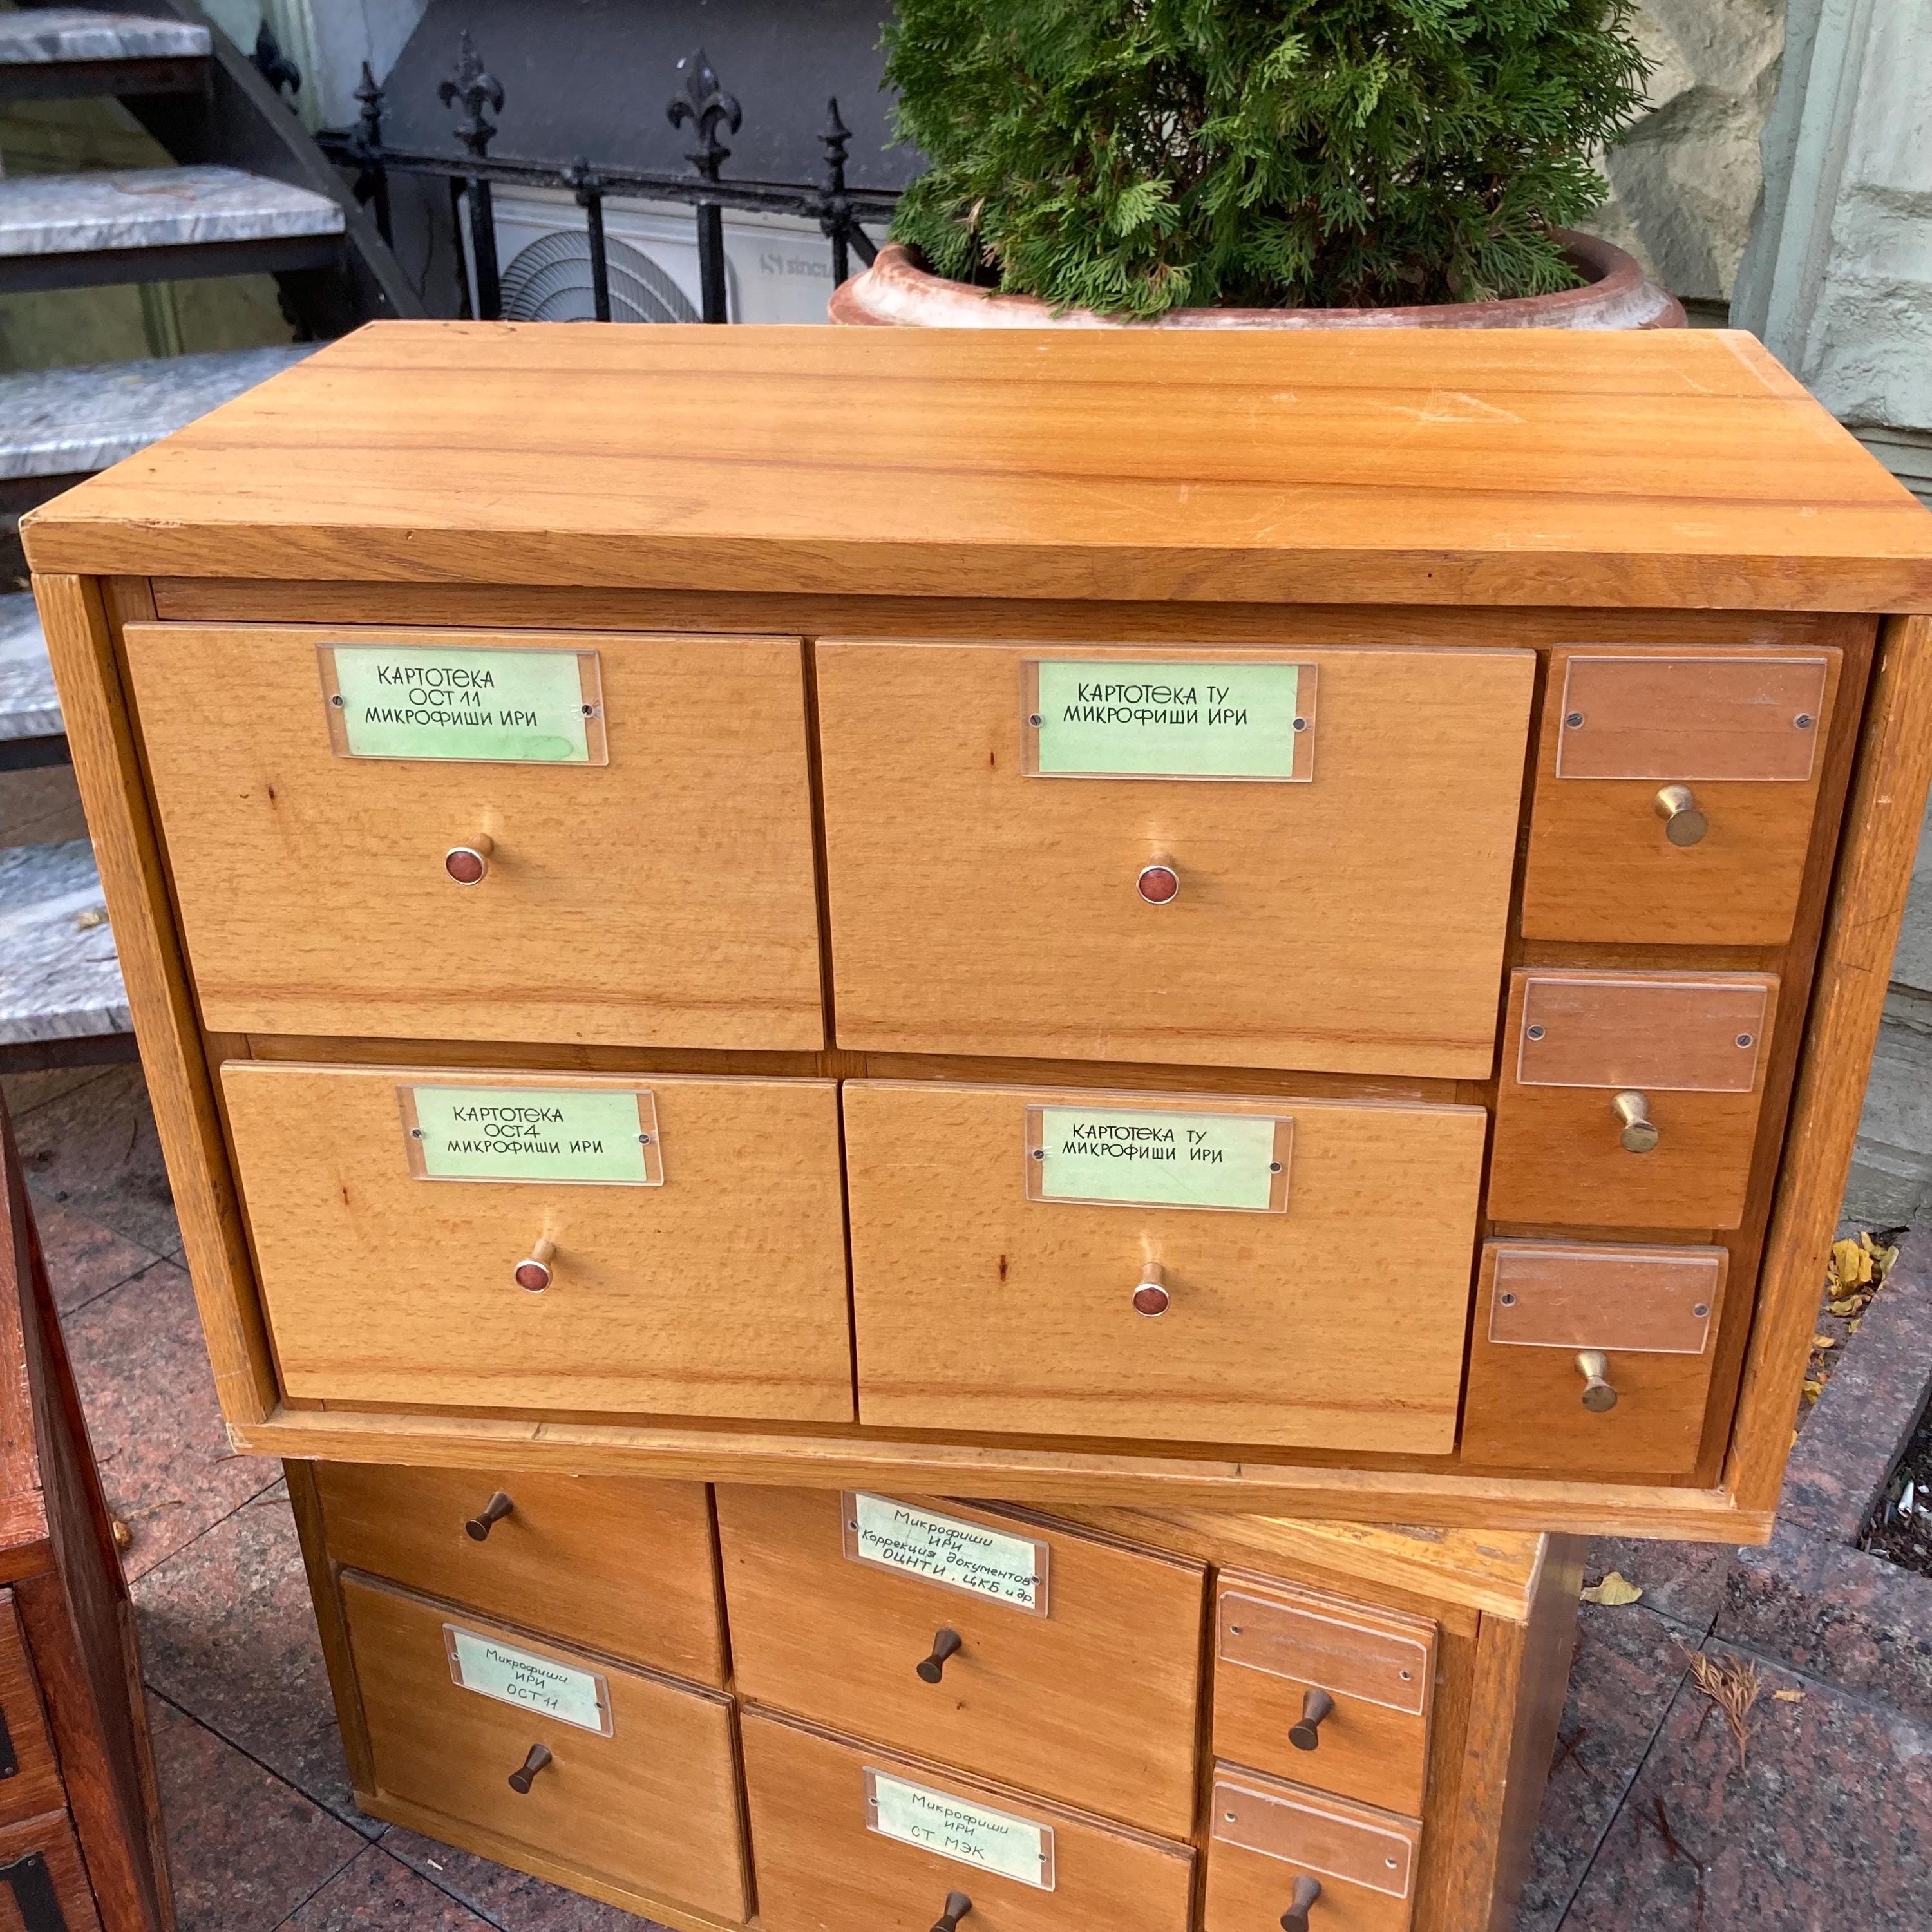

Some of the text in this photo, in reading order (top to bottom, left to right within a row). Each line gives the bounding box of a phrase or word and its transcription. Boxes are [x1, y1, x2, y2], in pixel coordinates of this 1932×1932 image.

[409, 688, 481, 707] ОСТ 11
[1207, 686, 1229, 705] ТУ
[365, 707, 538, 727] МИКРОФИШИ ИРИ
[1063, 705, 1247, 726] МИКРОФИШИ ИРИ
[1187, 1130, 1208, 1145] ТУ
[447, 1140, 604, 1155] МИКРОФИШИ ИРИ
[1061, 1141, 1224, 1164] МИКРОФИШИ ИРИ
[894, 1510, 994, 1547] Микрофиши
[928, 1535, 963, 1552] ИРИ
[862, 1529, 1031, 1586] Коррекция документов
[486, 1649, 569, 1683] Микрофиши
[516, 1671, 545, 1689] ИРИ
[507, 1683, 542, 1701] ОСТ
[911, 1793, 1010, 1834] Микрофиши
[944, 1820, 975, 1836] ИРИ
[911, 1824, 985, 1861] СТ МЭК
